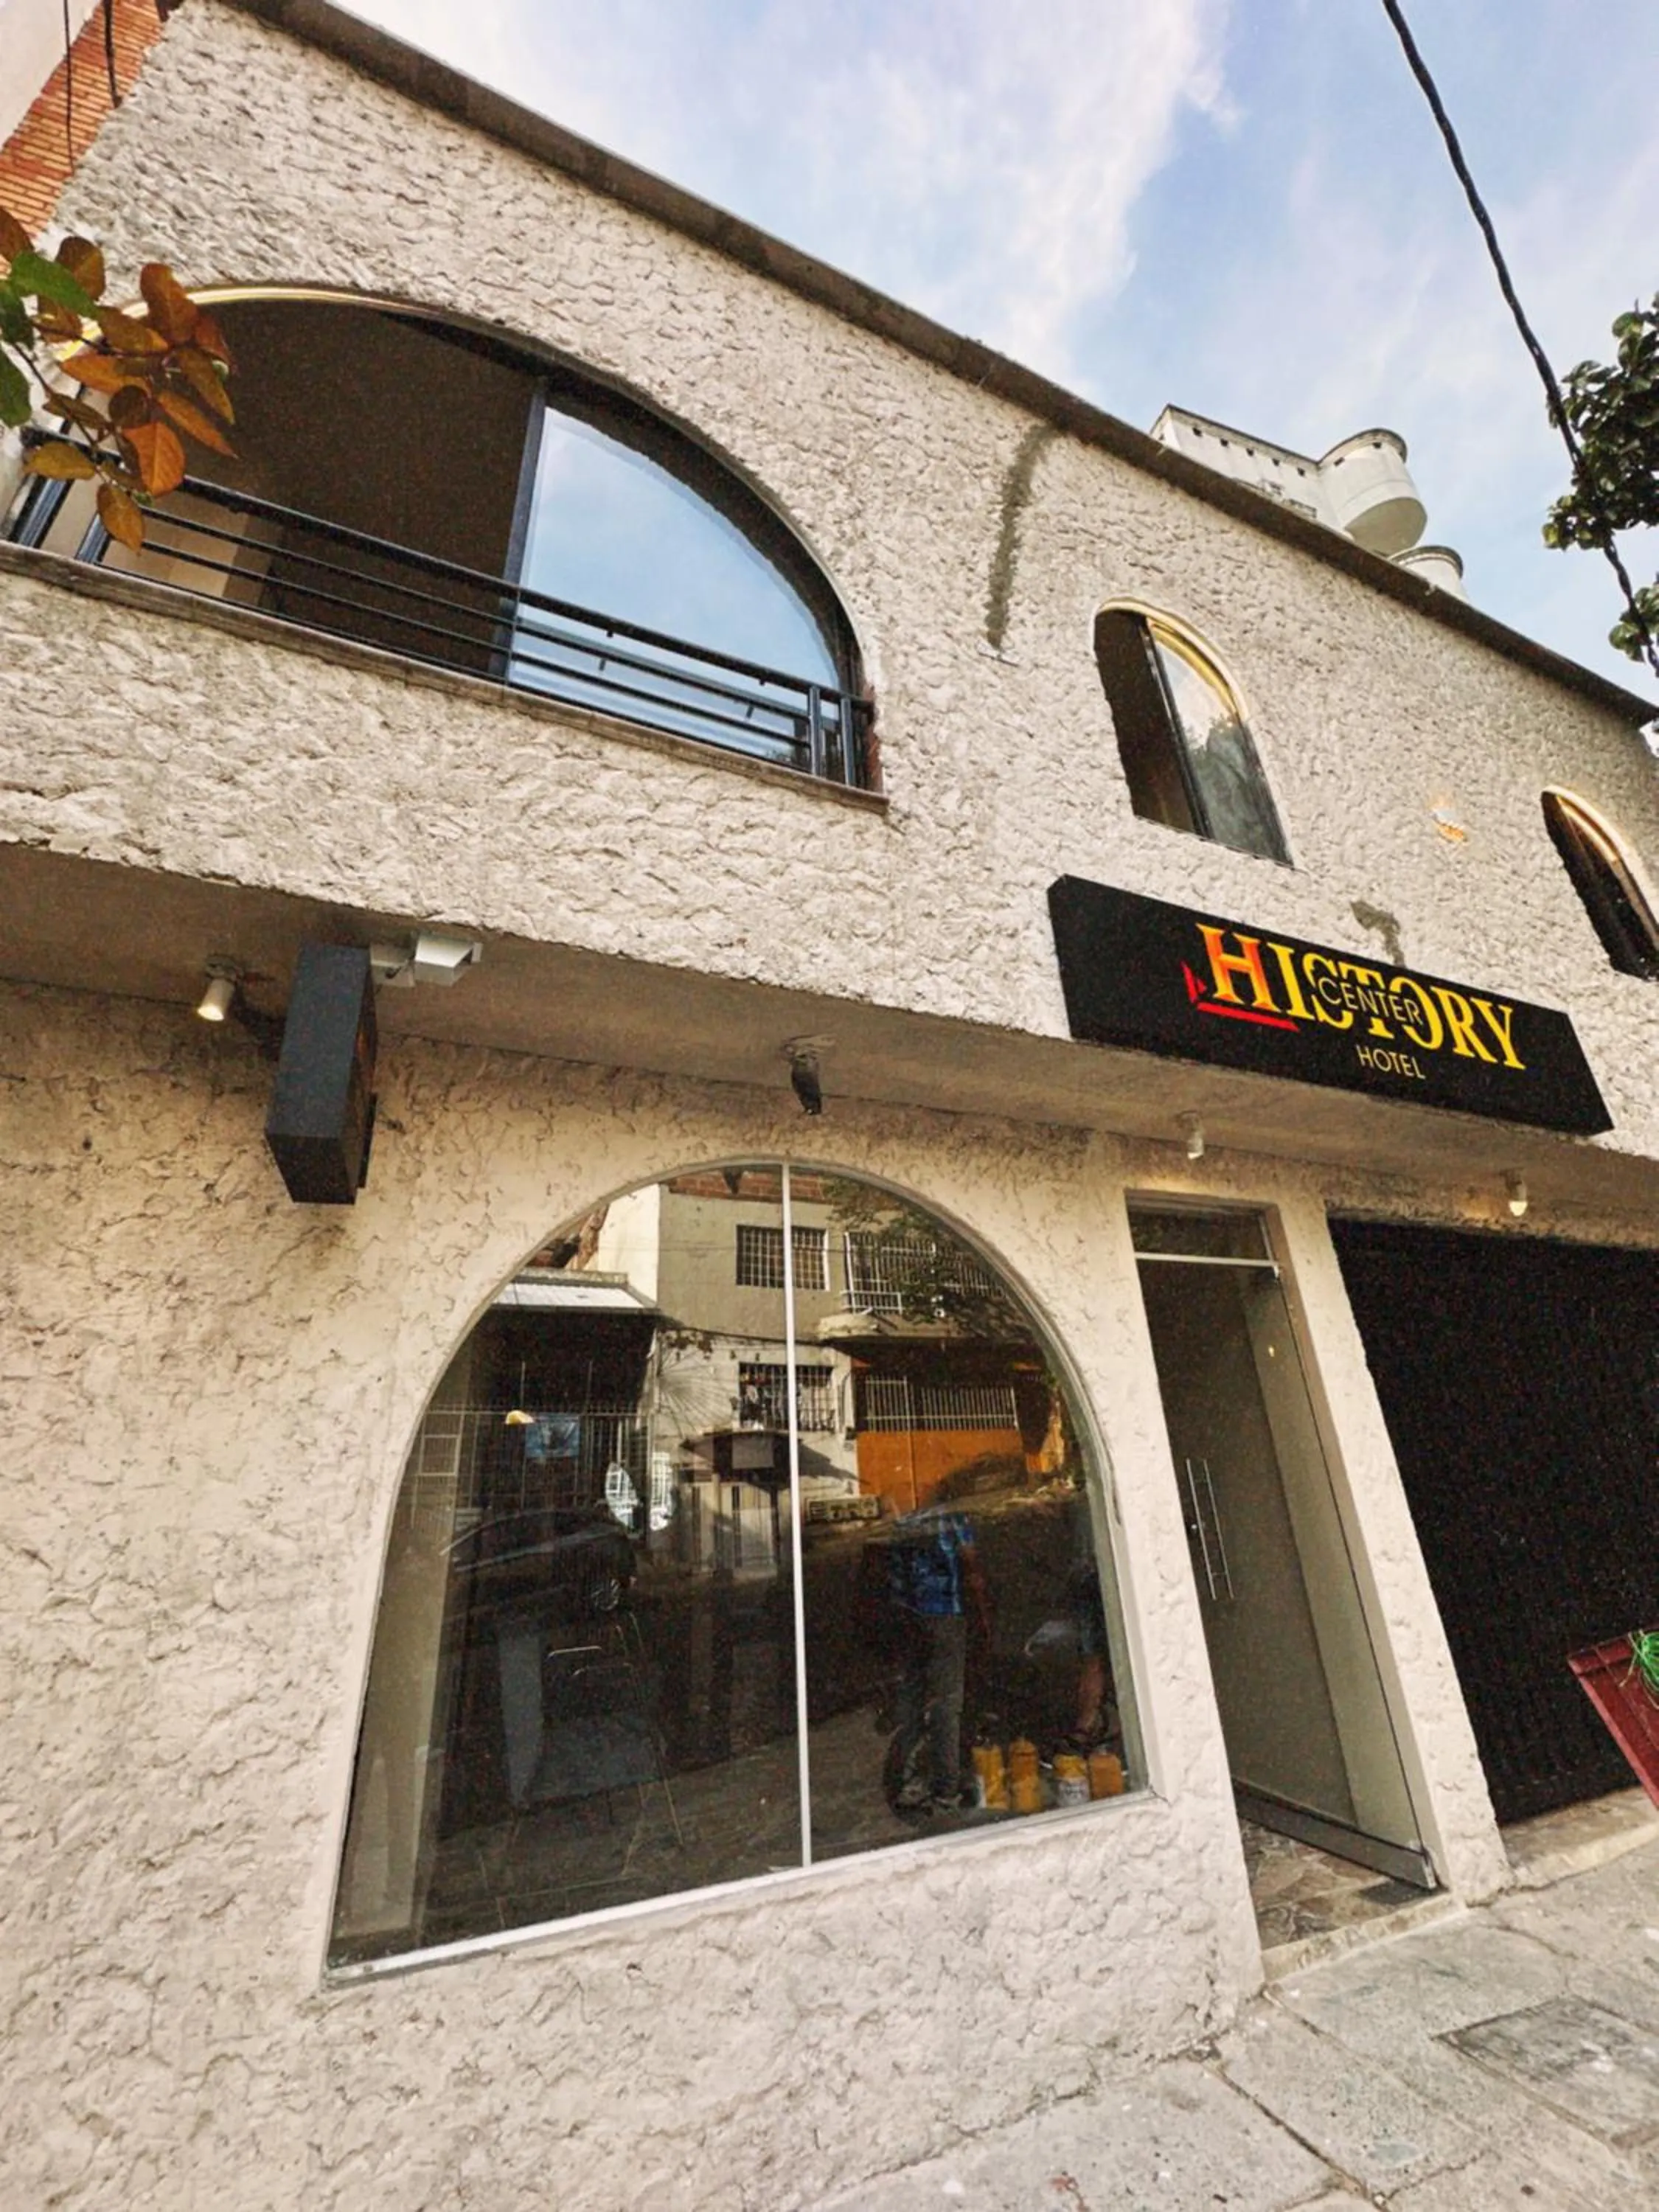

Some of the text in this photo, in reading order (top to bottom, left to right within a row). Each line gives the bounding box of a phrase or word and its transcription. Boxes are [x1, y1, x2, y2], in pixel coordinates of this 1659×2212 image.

[1197, 923, 1525, 1069] HISTORY
[1318, 977, 1423, 1026] CENTER
[1356, 1045, 1425, 1079] HOTEL
